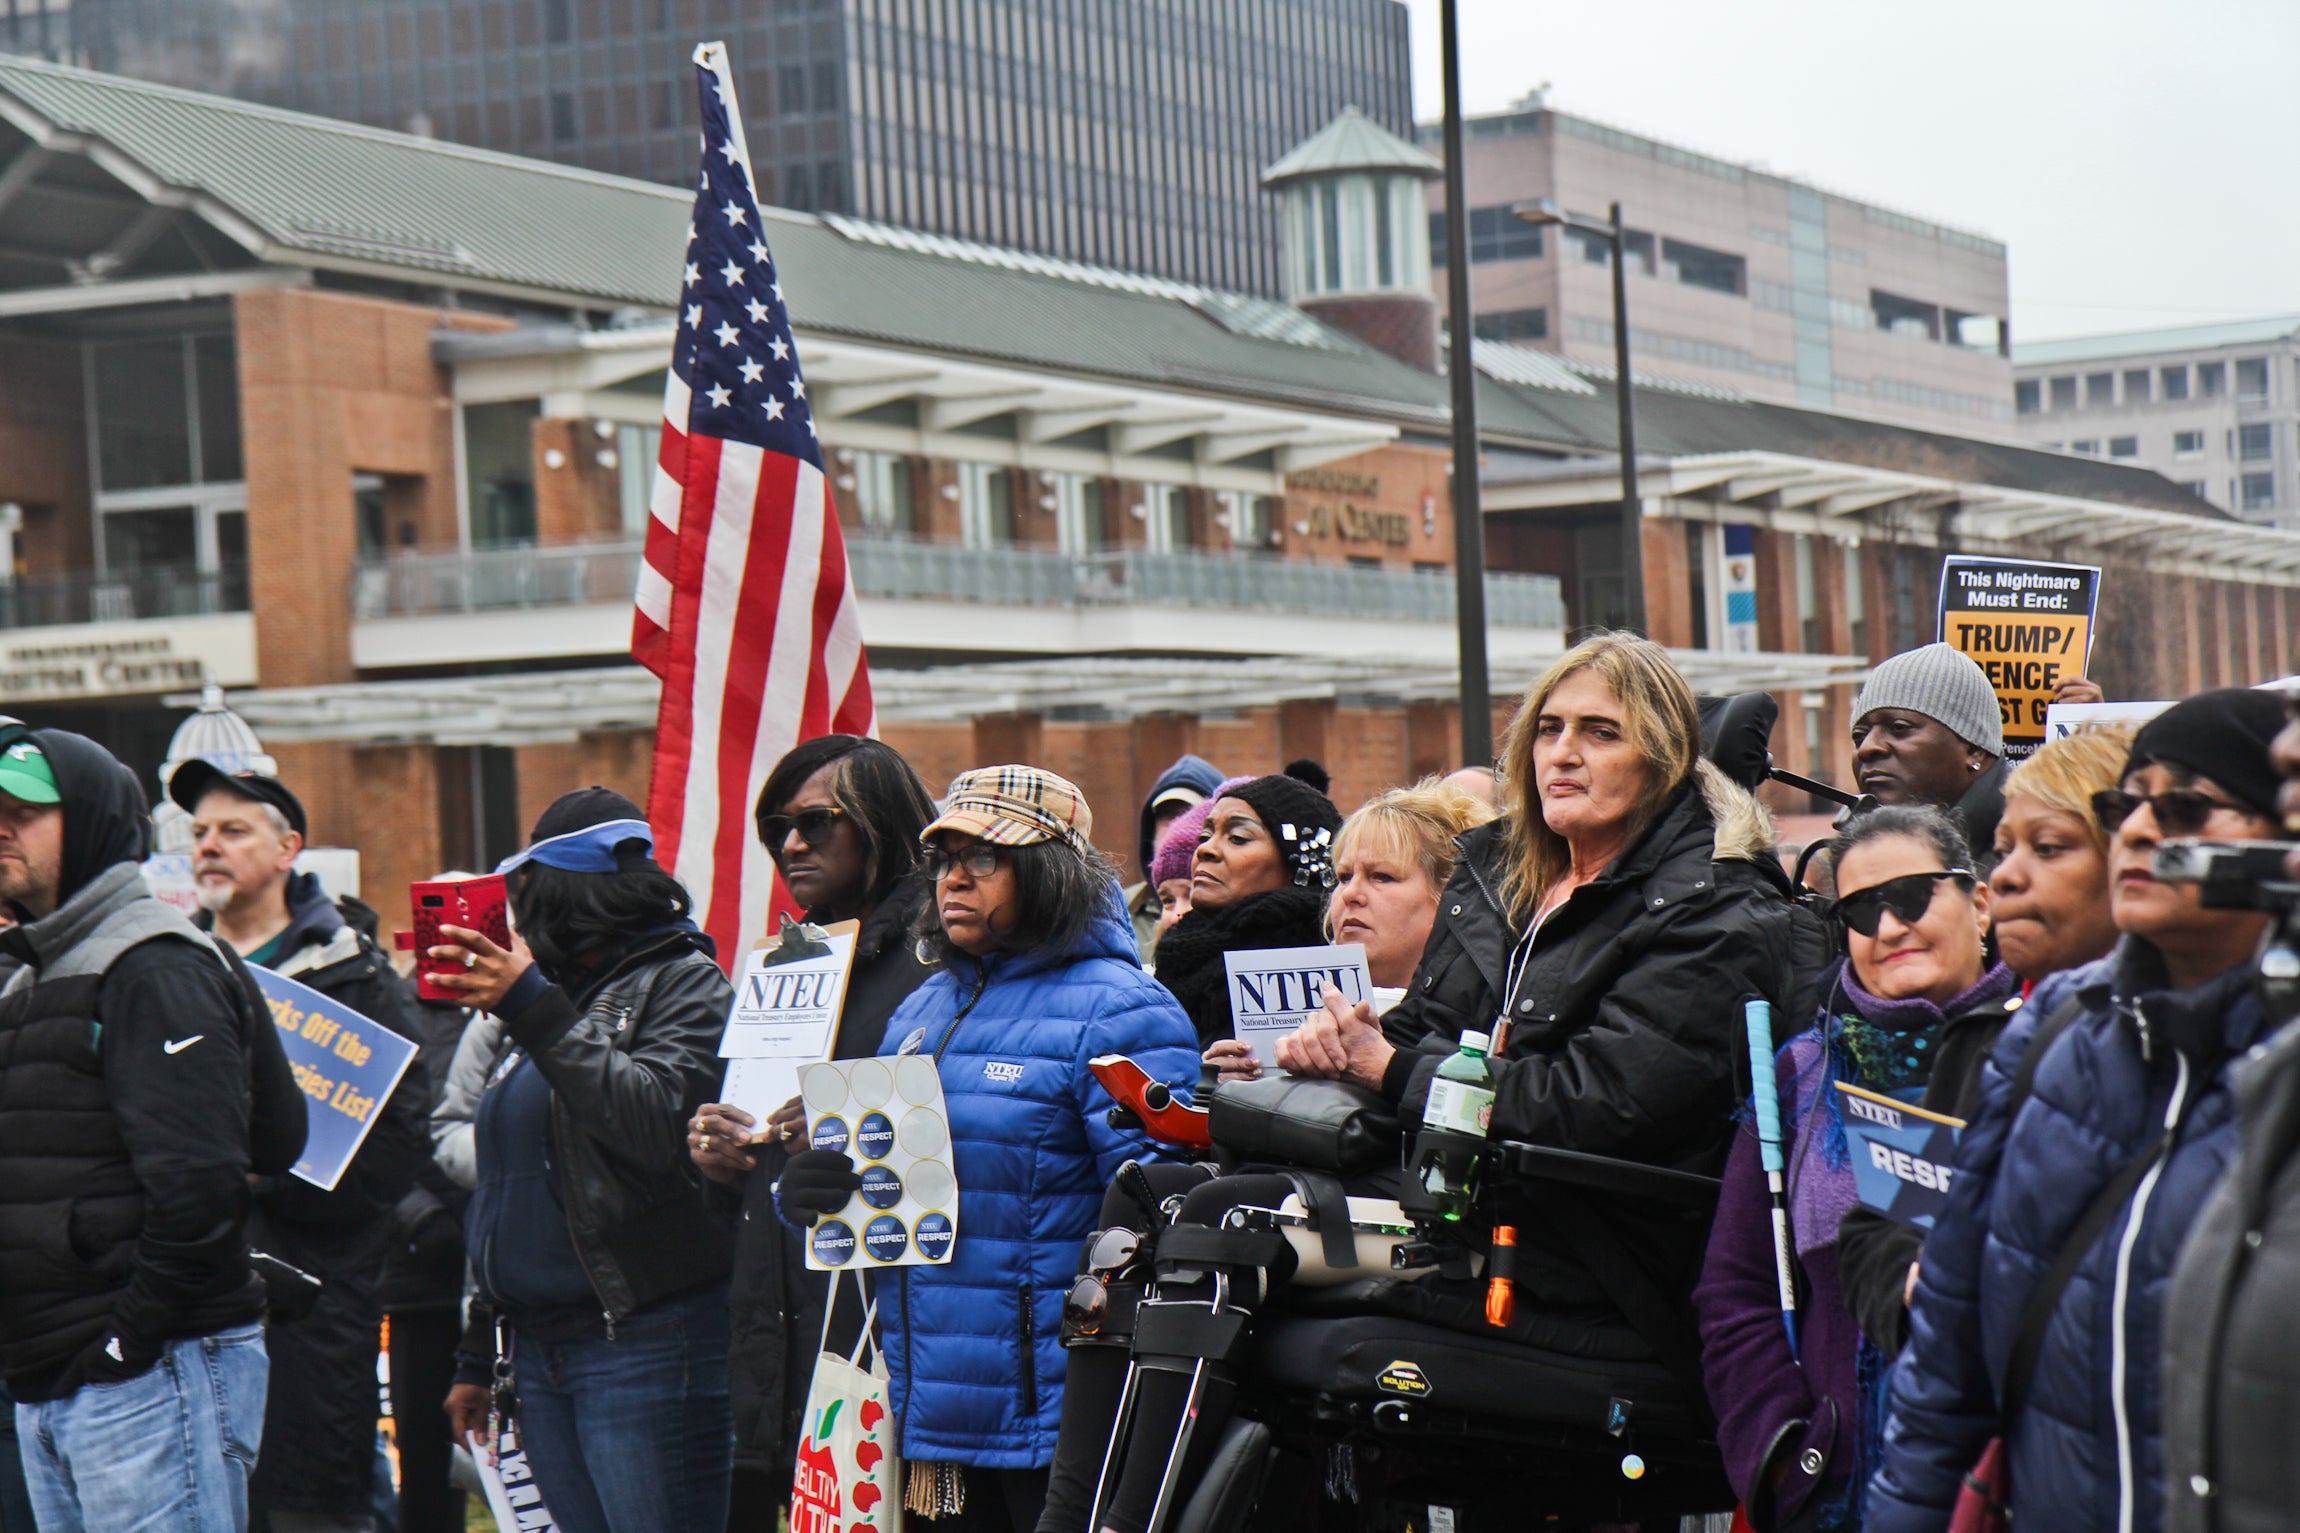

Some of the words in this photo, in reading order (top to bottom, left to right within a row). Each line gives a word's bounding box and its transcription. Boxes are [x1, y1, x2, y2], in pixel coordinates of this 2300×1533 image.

[1958, 571, 1992, 588] This
[1996, 571, 2081, 591] Nightmare
[1967, 590, 2018, 608] Must
[2023, 592, 2069, 610] End:
[1957, 623, 2076, 655] TRUMP/
[740, 972, 841, 1010] NTEU
[1235, 967, 1362, 1014] NTEU
[1241, 1016, 1270, 1027] National
[1270, 1016, 1303, 1027] Treasury
[301, 1011, 343, 1048] Off
[333, 1030, 372, 1067] the
[984, 1062, 1025, 1078] NTEU
[330, 1081, 375, 1123] List
[1847, 1095, 1903, 1132] NTEU
[813, 1134, 848, 1146] RESPECT
[858, 1132, 892, 1142] RESPECT
[862, 1182, 899, 1192] RESPECT
[814, 1238, 854, 1249] RESPECT
[866, 1233, 906, 1244] RESPECT
[917, 1232, 951, 1242] RESPECT
[1382, 1376, 1425, 1390] SOLUTION
